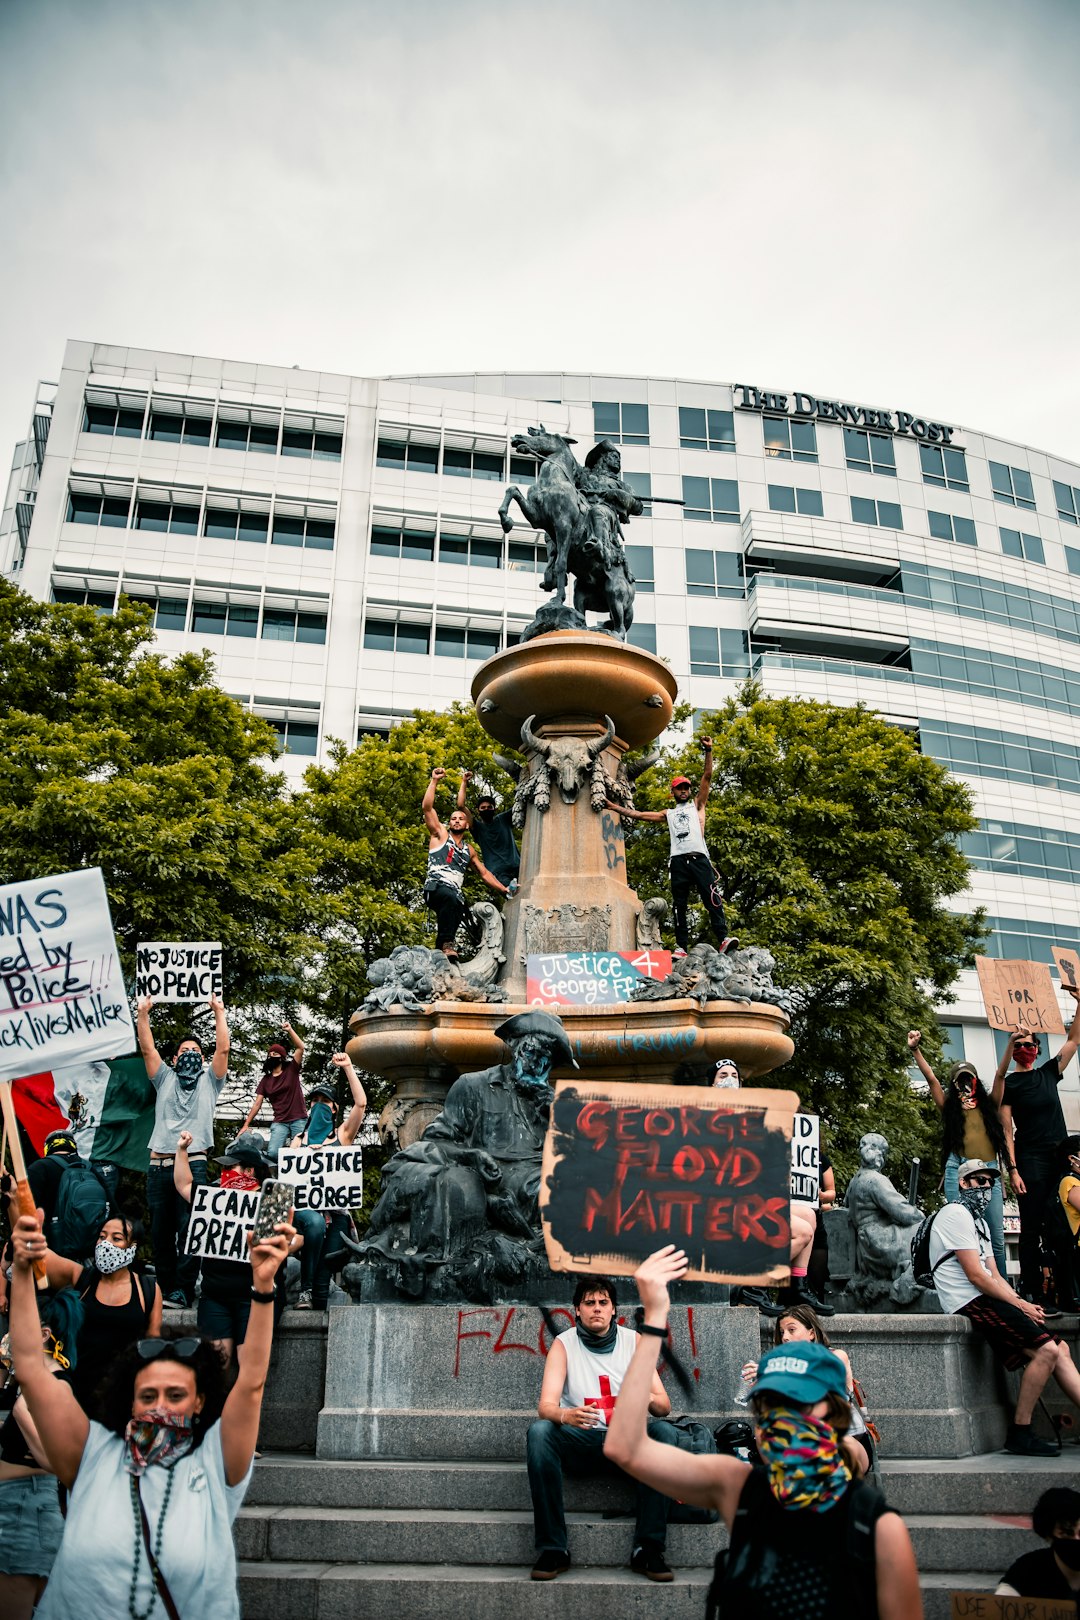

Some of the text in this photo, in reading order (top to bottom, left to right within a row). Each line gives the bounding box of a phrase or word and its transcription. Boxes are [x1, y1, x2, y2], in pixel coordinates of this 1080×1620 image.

[734, 384, 953, 443] THE DENVER POST
[39, 937, 72, 979] by
[159, 948, 222, 971] JUSTICE
[539, 951, 659, 978] Justice 4
[137, 971, 222, 997] NO PEACE
[540, 978, 608, 1004] George
[1008, 989, 1033, 1004] FOR
[992, 1005, 1051, 1030] BLACK
[608, 1027, 697, 1056] TRUMP
[577, 1102, 764, 1150] GEORGE
[281, 1152, 362, 1175] JUSTICE
[614, 1142, 762, 1187] FLOYD
[791, 1144, 819, 1169] ICE
[194, 1189, 208, 1211] I
[294, 1185, 362, 1209] EORGE
[582, 1188, 791, 1249] MATTERS
[955, 1596, 987, 1618] USE
